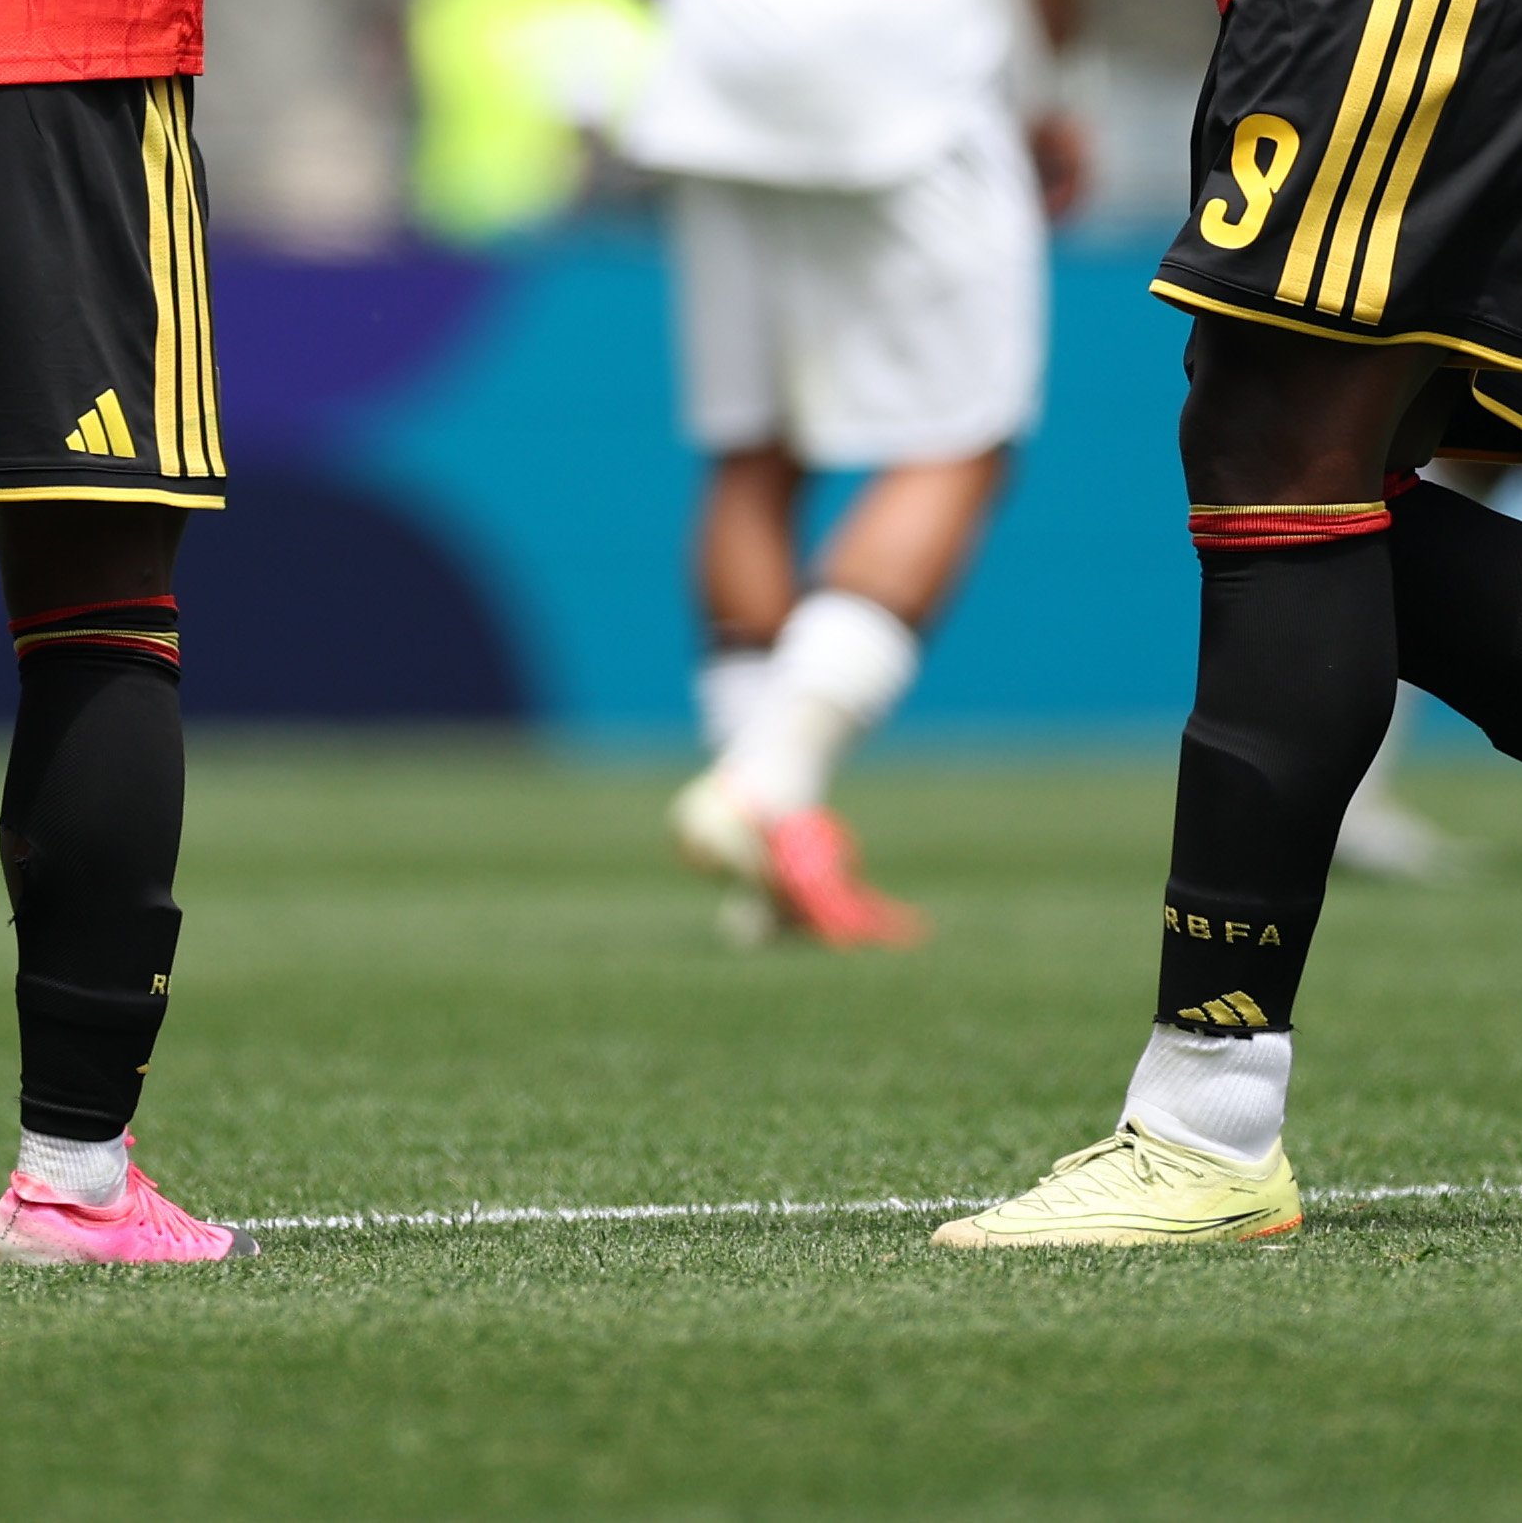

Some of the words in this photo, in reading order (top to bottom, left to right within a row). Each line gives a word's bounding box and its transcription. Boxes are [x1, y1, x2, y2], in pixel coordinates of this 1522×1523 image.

[1198, 112, 1301, 250] 9
[1164, 904, 1281, 946] RBFA
[149, 973, 172, 996] R
